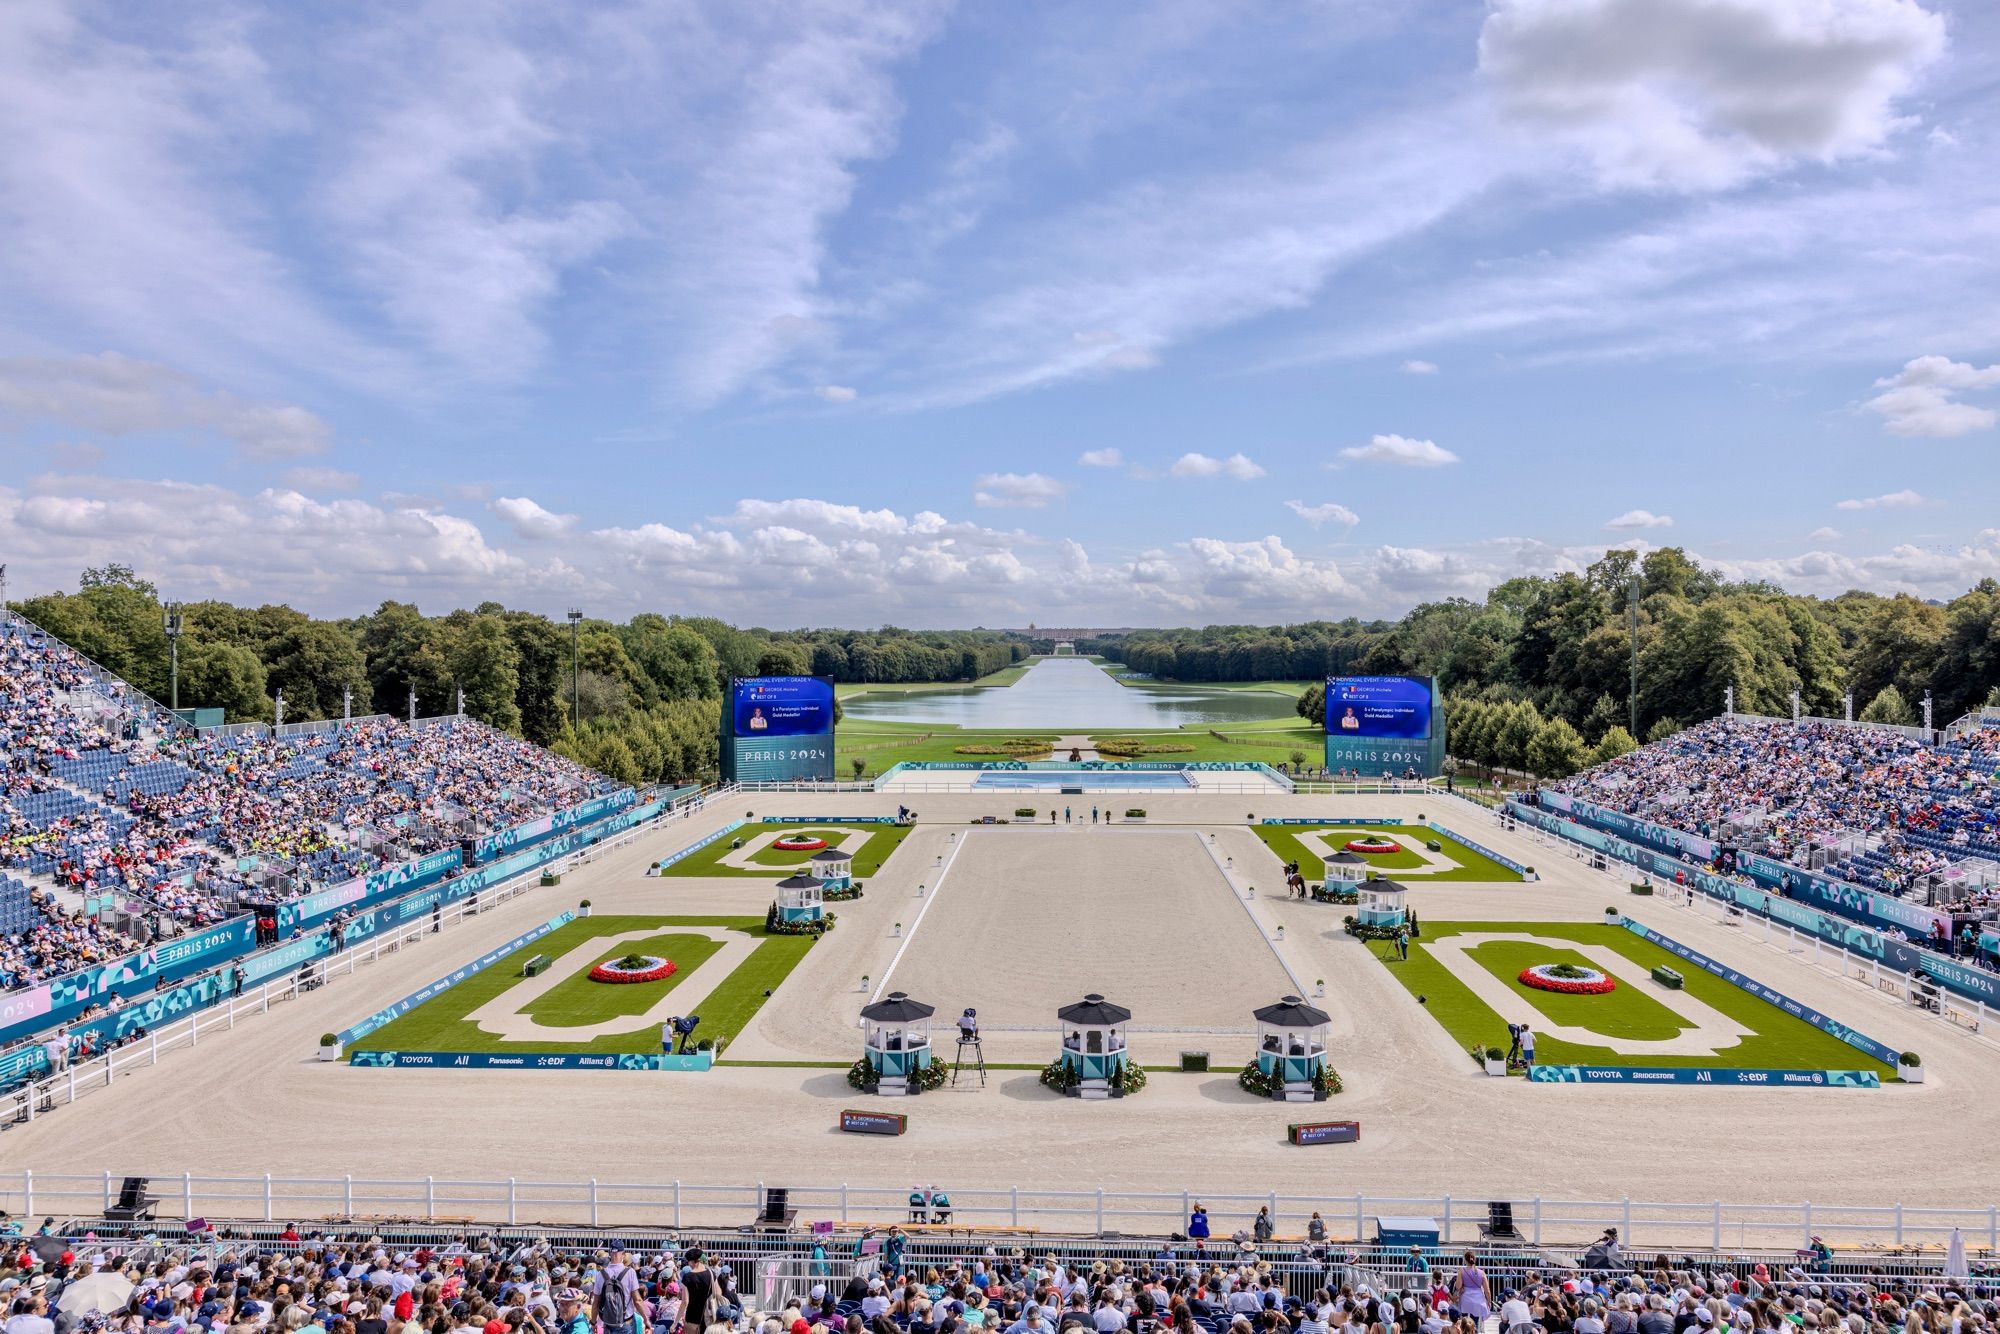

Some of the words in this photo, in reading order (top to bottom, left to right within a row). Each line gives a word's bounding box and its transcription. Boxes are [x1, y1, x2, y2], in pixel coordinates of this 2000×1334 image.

[745, 750, 784, 761] PARIS
[790, 749, 825, 760] 2024
[1336, 750, 1377, 761] PARIS
[1383, 752, 1421, 763] 2024
[424, 856, 441, 870] PARIS
[442, 854, 458, 864] 2024
[1760, 864, 1780, 878] PARIS
[313, 894, 336, 909] PARIS
[406, 899, 424, 912] PARIS
[426, 892, 441, 905] 2024
[1883, 904, 1910, 920] PARIS
[169, 940, 201, 961] PARIS
[204, 931, 232, 949] 2024
[256, 956, 282, 973] PARIS
[284, 945, 307, 962] 2024
[1931, 962, 1960, 982] PARIS
[1964, 975, 1993, 994] 2024
[416, 990, 432, 1000] TOYOTA
[1784, 1001, 1802, 1013] TOYOTA
[16, 1050, 44, 1071] PAR
[1586, 1070, 1622, 1079] TOYOTA
[1784, 1074, 1811, 1082] Allianz
